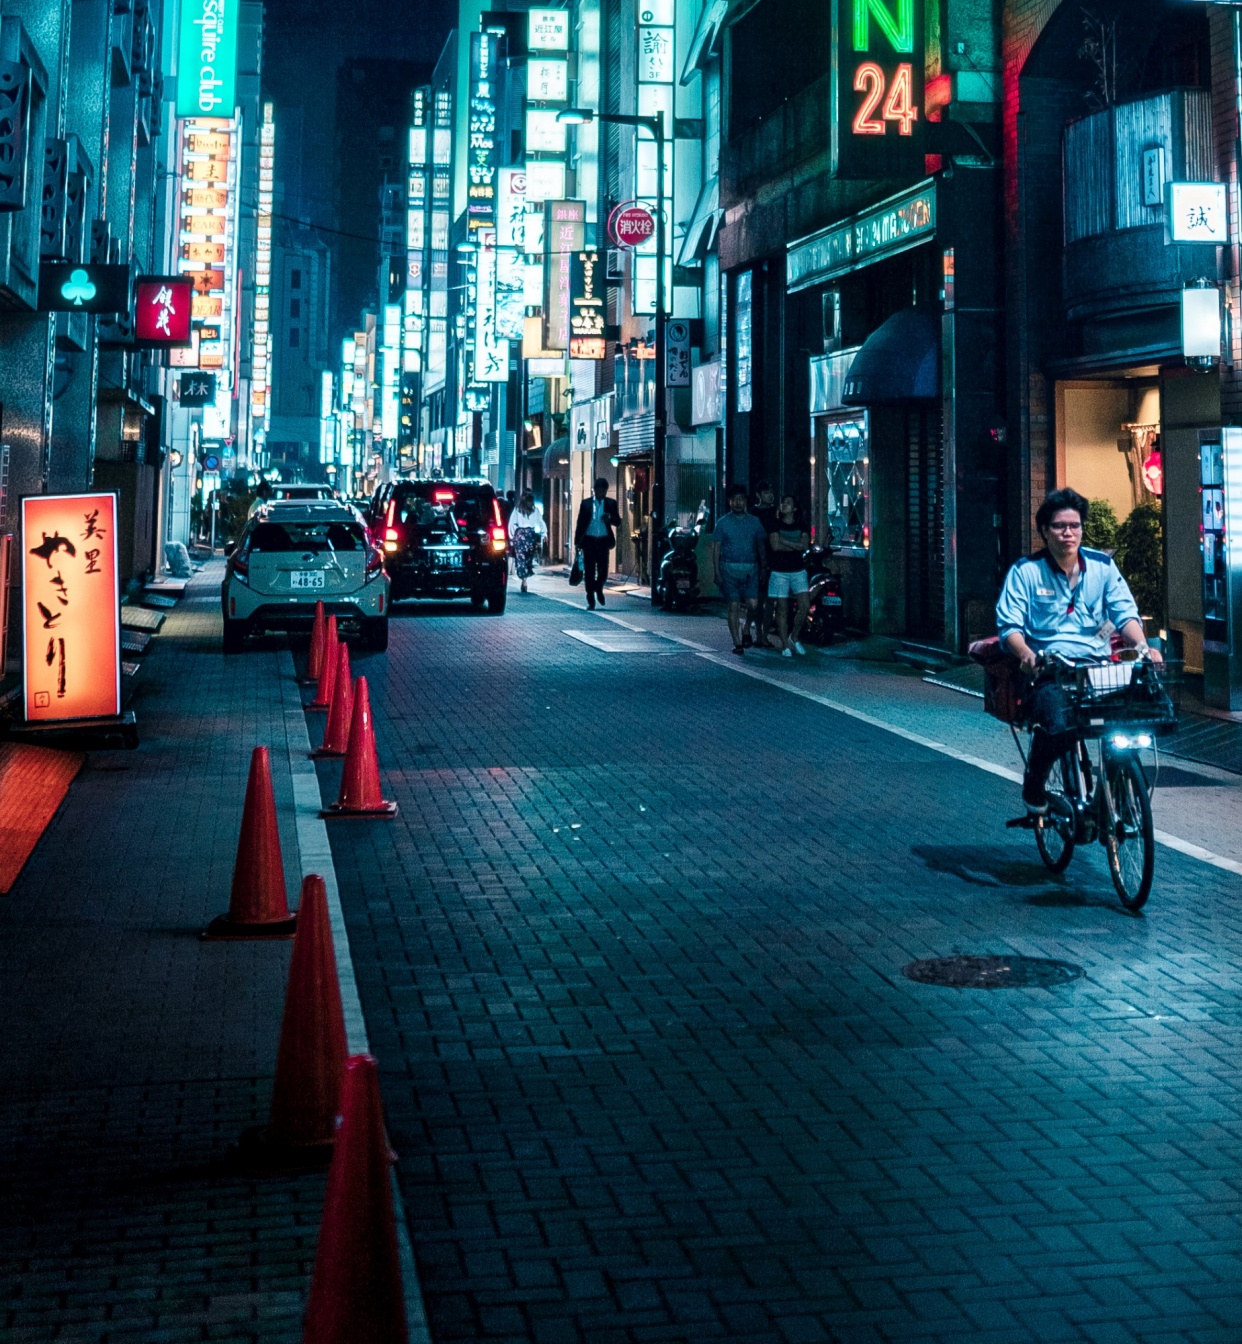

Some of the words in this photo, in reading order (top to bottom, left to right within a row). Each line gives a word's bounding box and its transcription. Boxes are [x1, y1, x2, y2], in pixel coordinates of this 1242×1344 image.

[198, 66, 223, 112] club
[853, 62, 917, 136] 24
[557, 209, 579, 220] 銀座
[620, 219, 652, 235] 消火栓
[1186, 206, 1215, 234] 誠
[81, 509, 106, 575] 美里
[29, 531, 76, 699] やきとり
